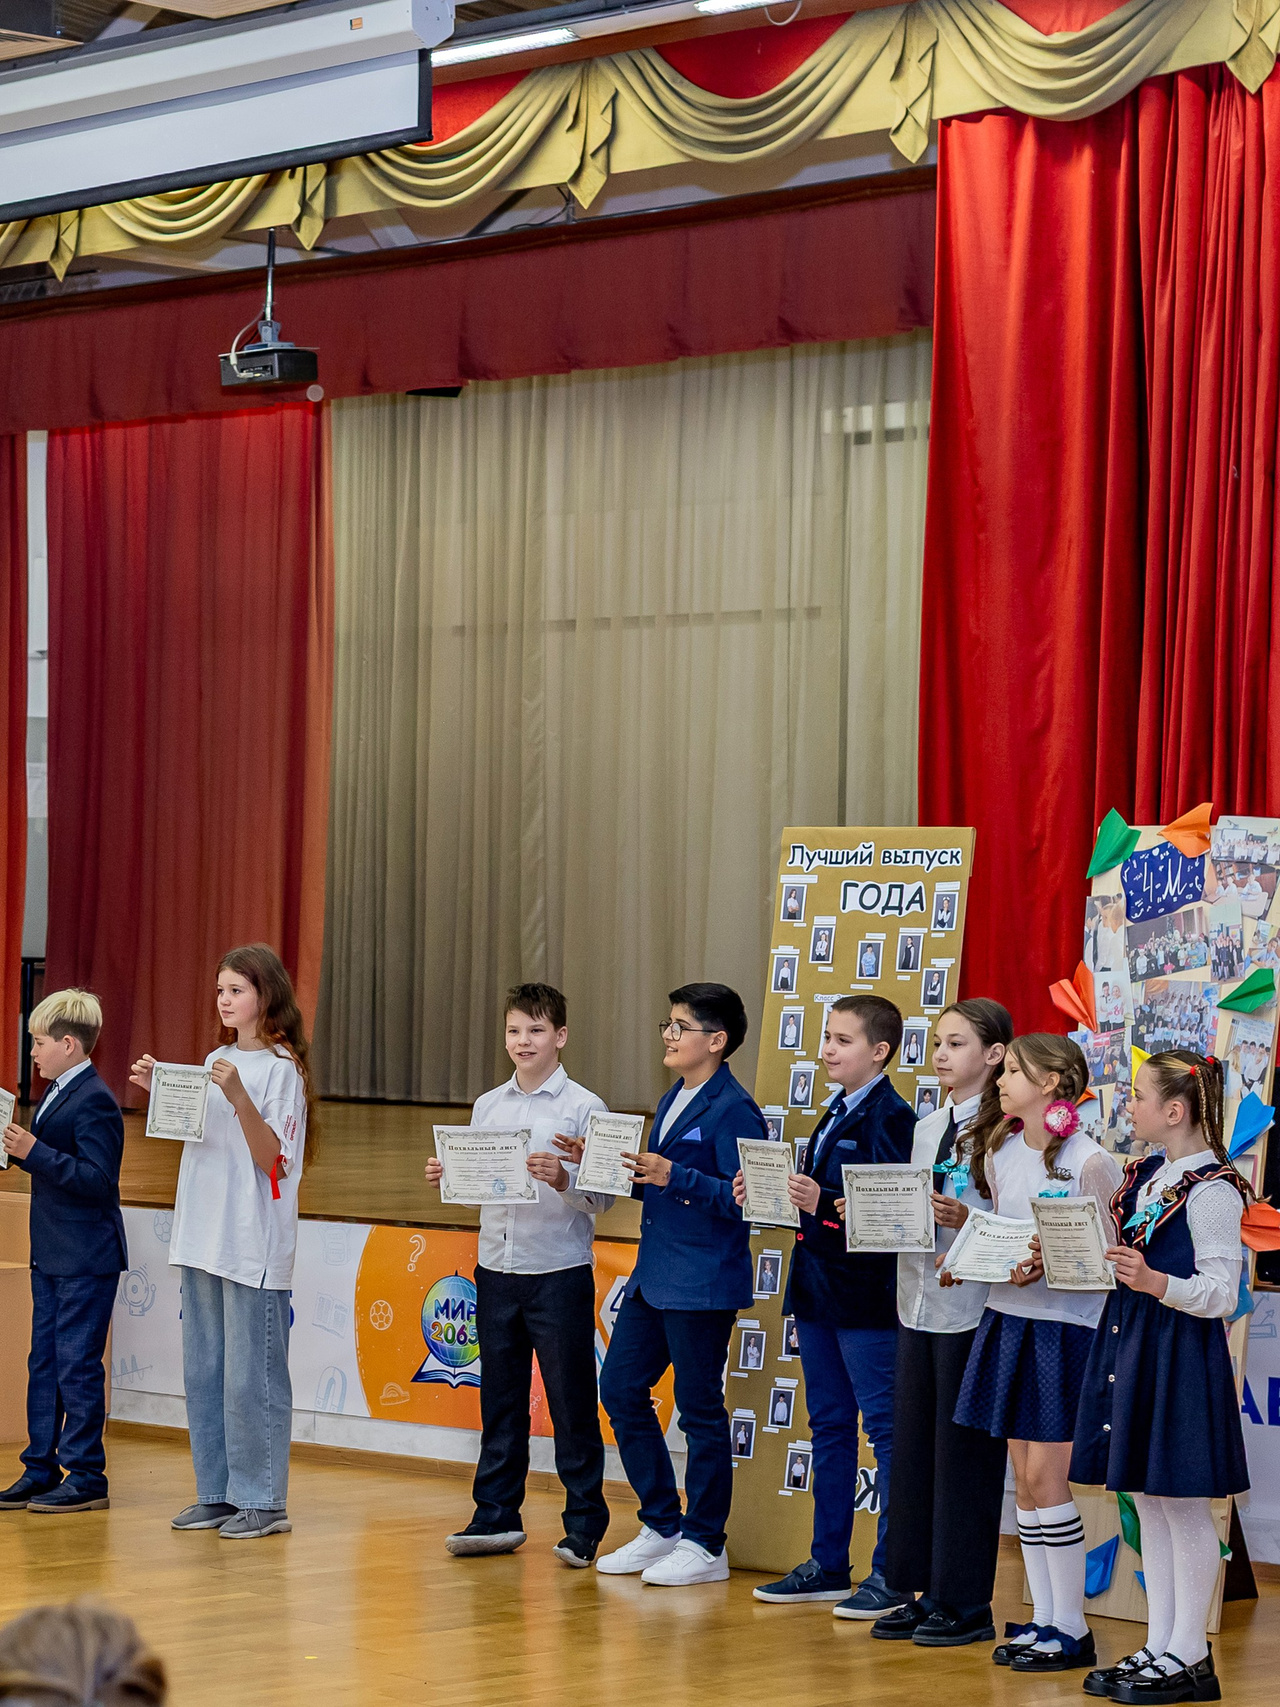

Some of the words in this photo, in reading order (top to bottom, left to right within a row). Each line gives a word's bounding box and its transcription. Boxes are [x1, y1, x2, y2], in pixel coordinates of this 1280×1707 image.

[788, 843, 873, 871] Лучший
[881, 850, 961, 871] выпуск
[842, 882, 925, 916] ГОДА
[434, 1298, 478, 1322] МИР
[431, 1321, 479, 1346] 2065
